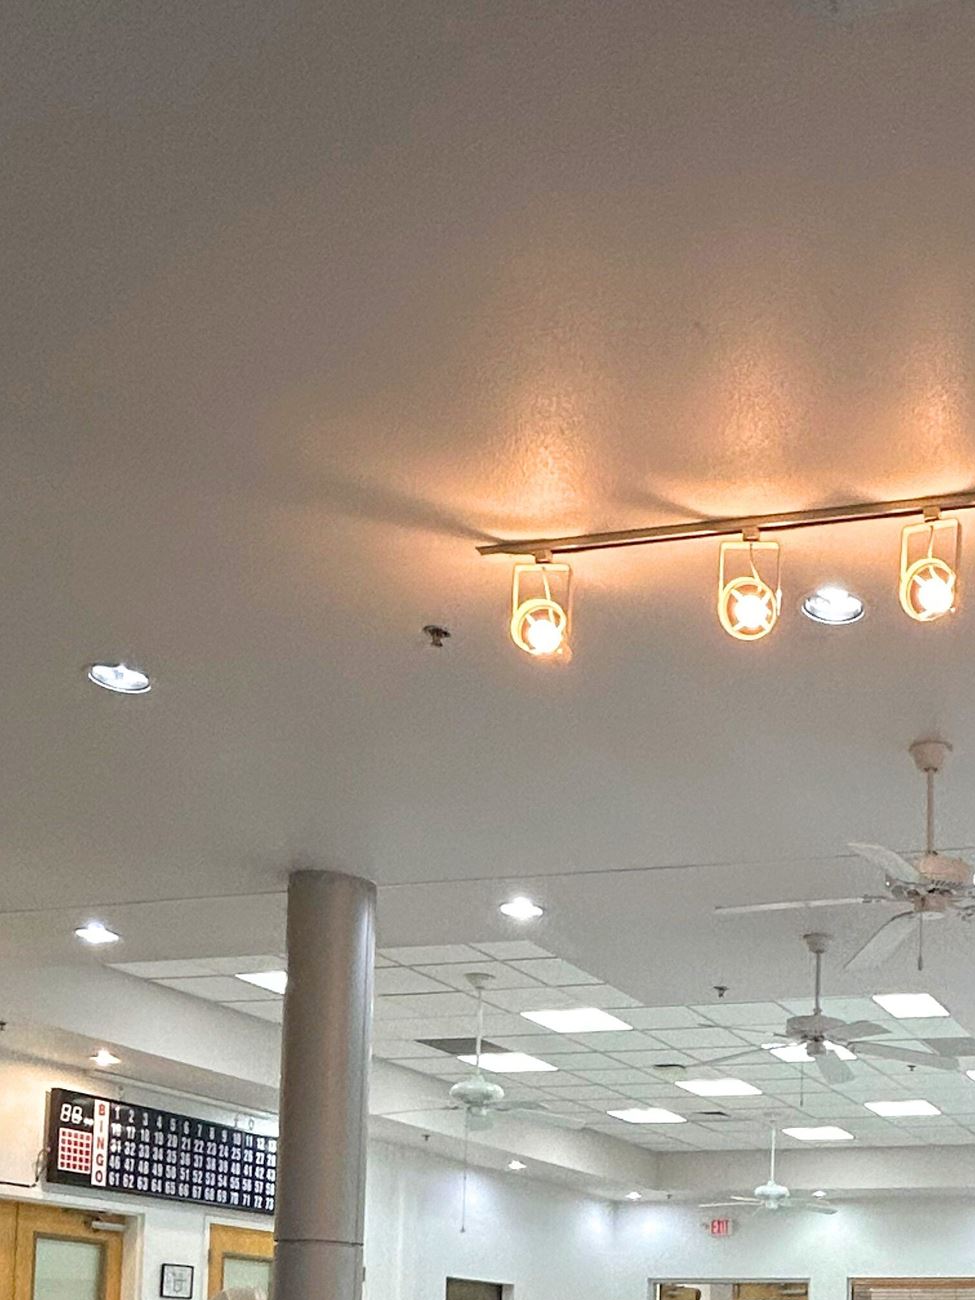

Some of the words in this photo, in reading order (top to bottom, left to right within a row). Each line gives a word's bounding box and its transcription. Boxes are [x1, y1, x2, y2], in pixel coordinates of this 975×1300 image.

[95, 1104, 106, 1182] BINGO
[115, 1105, 120, 1120] 1
[129, 1109, 134, 1123] 2
[170, 1118, 176, 1131] 5
[184, 1121, 189, 1134] 6
[198, 1124, 202, 1137] 7
[222, 1130, 227, 1142] 9
[246, 1135, 252, 1147] 11
[126, 1126, 136, 1139] 17
[182, 1137, 191, 1150] 21
[194, 1140, 204, 1153] 22
[207, 1142, 217, 1156] 23
[219, 1144, 229, 1158] 24
[231, 1147, 241, 1160] 25
[256, 1152, 264, 1165] 27
[109, 1155, 120, 1170] 46
[124, 1158, 135, 1172] 47
[152, 1163, 163, 1177] 49
[180, 1167, 189, 1181] 51
[192, 1170, 202, 1184] 52
[205, 1172, 215, 1186] 53
[218, 1174, 227, 1187] 54
[230, 1176, 240, 1190] 55
[254, 1181, 263, 1194] 57
[124, 1141, 136, 1156] 32
[153, 1147, 163, 1161] 34
[194, 1154, 203, 1168] 37
[243, 1164, 252, 1177] 41
[255, 1166, 264, 1180] 42
[109, 1171, 119, 1186] 61
[123, 1174, 134, 1188] 62
[137, 1176, 148, 1190] 63
[151, 1178, 162, 1192] 64
[165, 1181, 175, 1195] 65
[179, 1183, 189, 1197] 66
[192, 1185, 201, 1199] 67
[217, 1190, 227, 1203] 69
[230, 1191, 239, 1205] 70
[242, 1194, 250, 1206] 71
[254, 1195, 262, 1208] 72
[711, 1219, 729, 1234] EXIT
